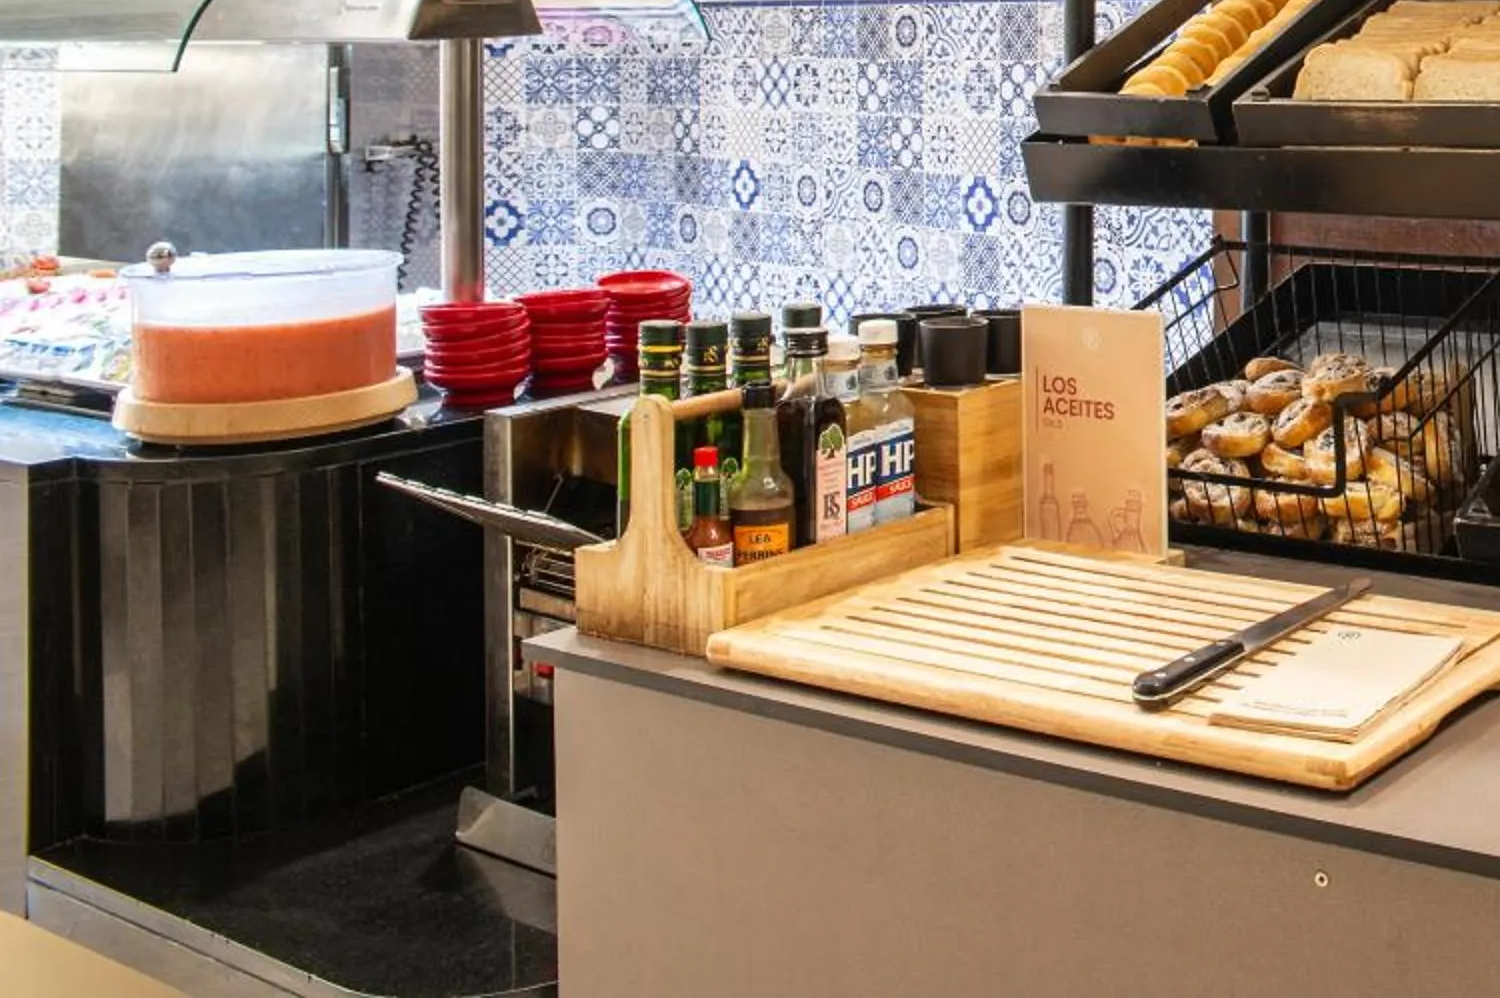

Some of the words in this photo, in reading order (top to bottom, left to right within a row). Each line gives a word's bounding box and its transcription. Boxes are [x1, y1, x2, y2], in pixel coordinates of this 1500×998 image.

[1043, 374, 1077, 395] LOS
[1043, 396, 1115, 420] ACEITES
[847, 451, 877, 489] HP
[881, 439, 915, 477] HP
